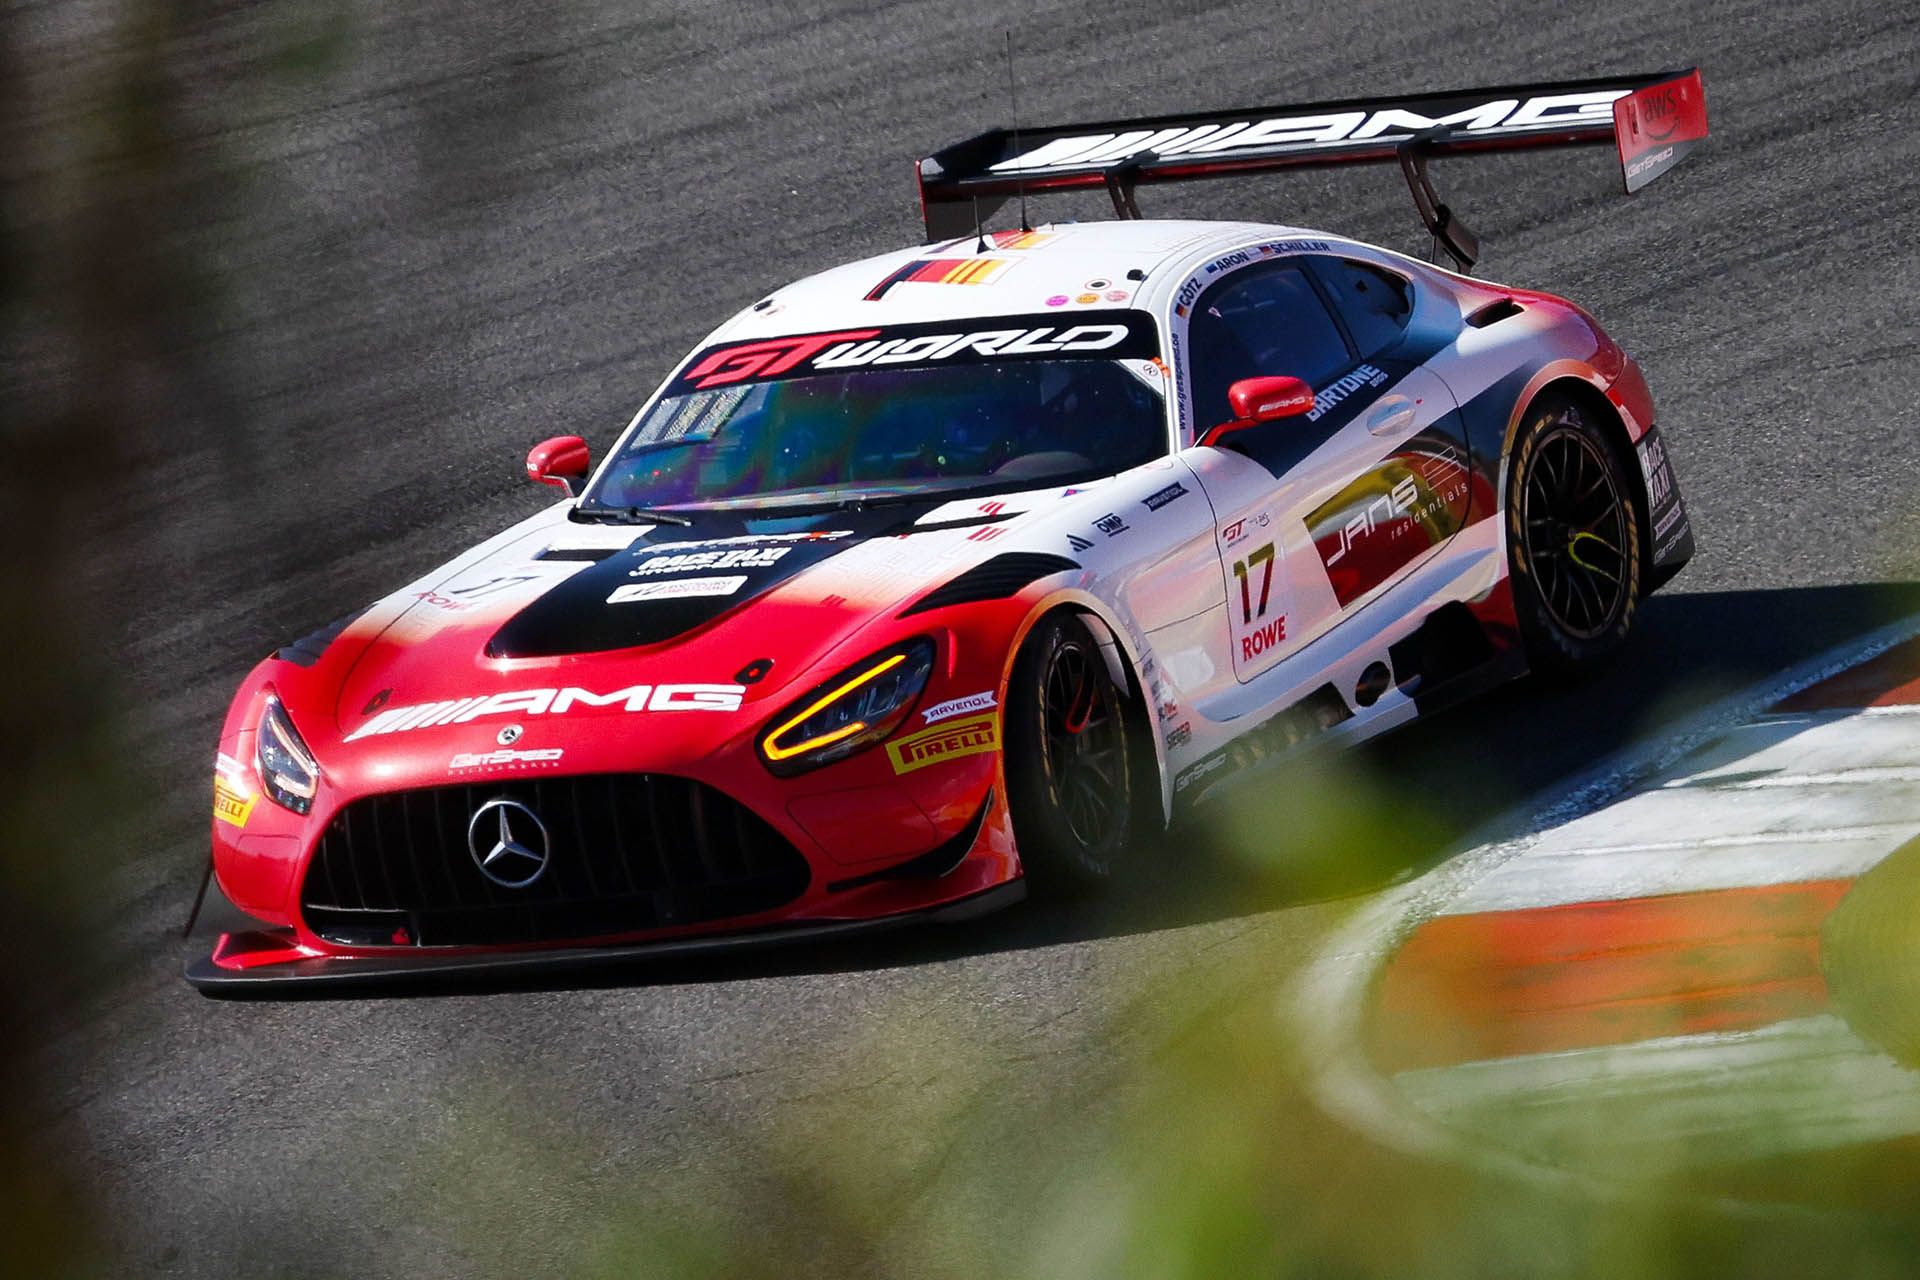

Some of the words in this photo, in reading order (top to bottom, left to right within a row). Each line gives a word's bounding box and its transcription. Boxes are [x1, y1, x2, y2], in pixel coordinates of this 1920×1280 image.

[1215, 251, 1250, 272] ARON
[1269, 241, 1332, 254] SCHILLER
[1179, 277, 1202, 307] GÖTZ
[685, 329, 882, 389] GT
[811, 324, 1130, 368] WORLD
[1305, 364, 1380, 422] BARTONE
[1097, 515, 1123, 533] OMP
[1390, 480, 1469, 541] residentials
[1233, 541, 1274, 625] 17
[1241, 615, 1287, 662] ROWE
[929, 697, 990, 719] RAVENOL
[897, 721, 996, 766] PIRELLI
